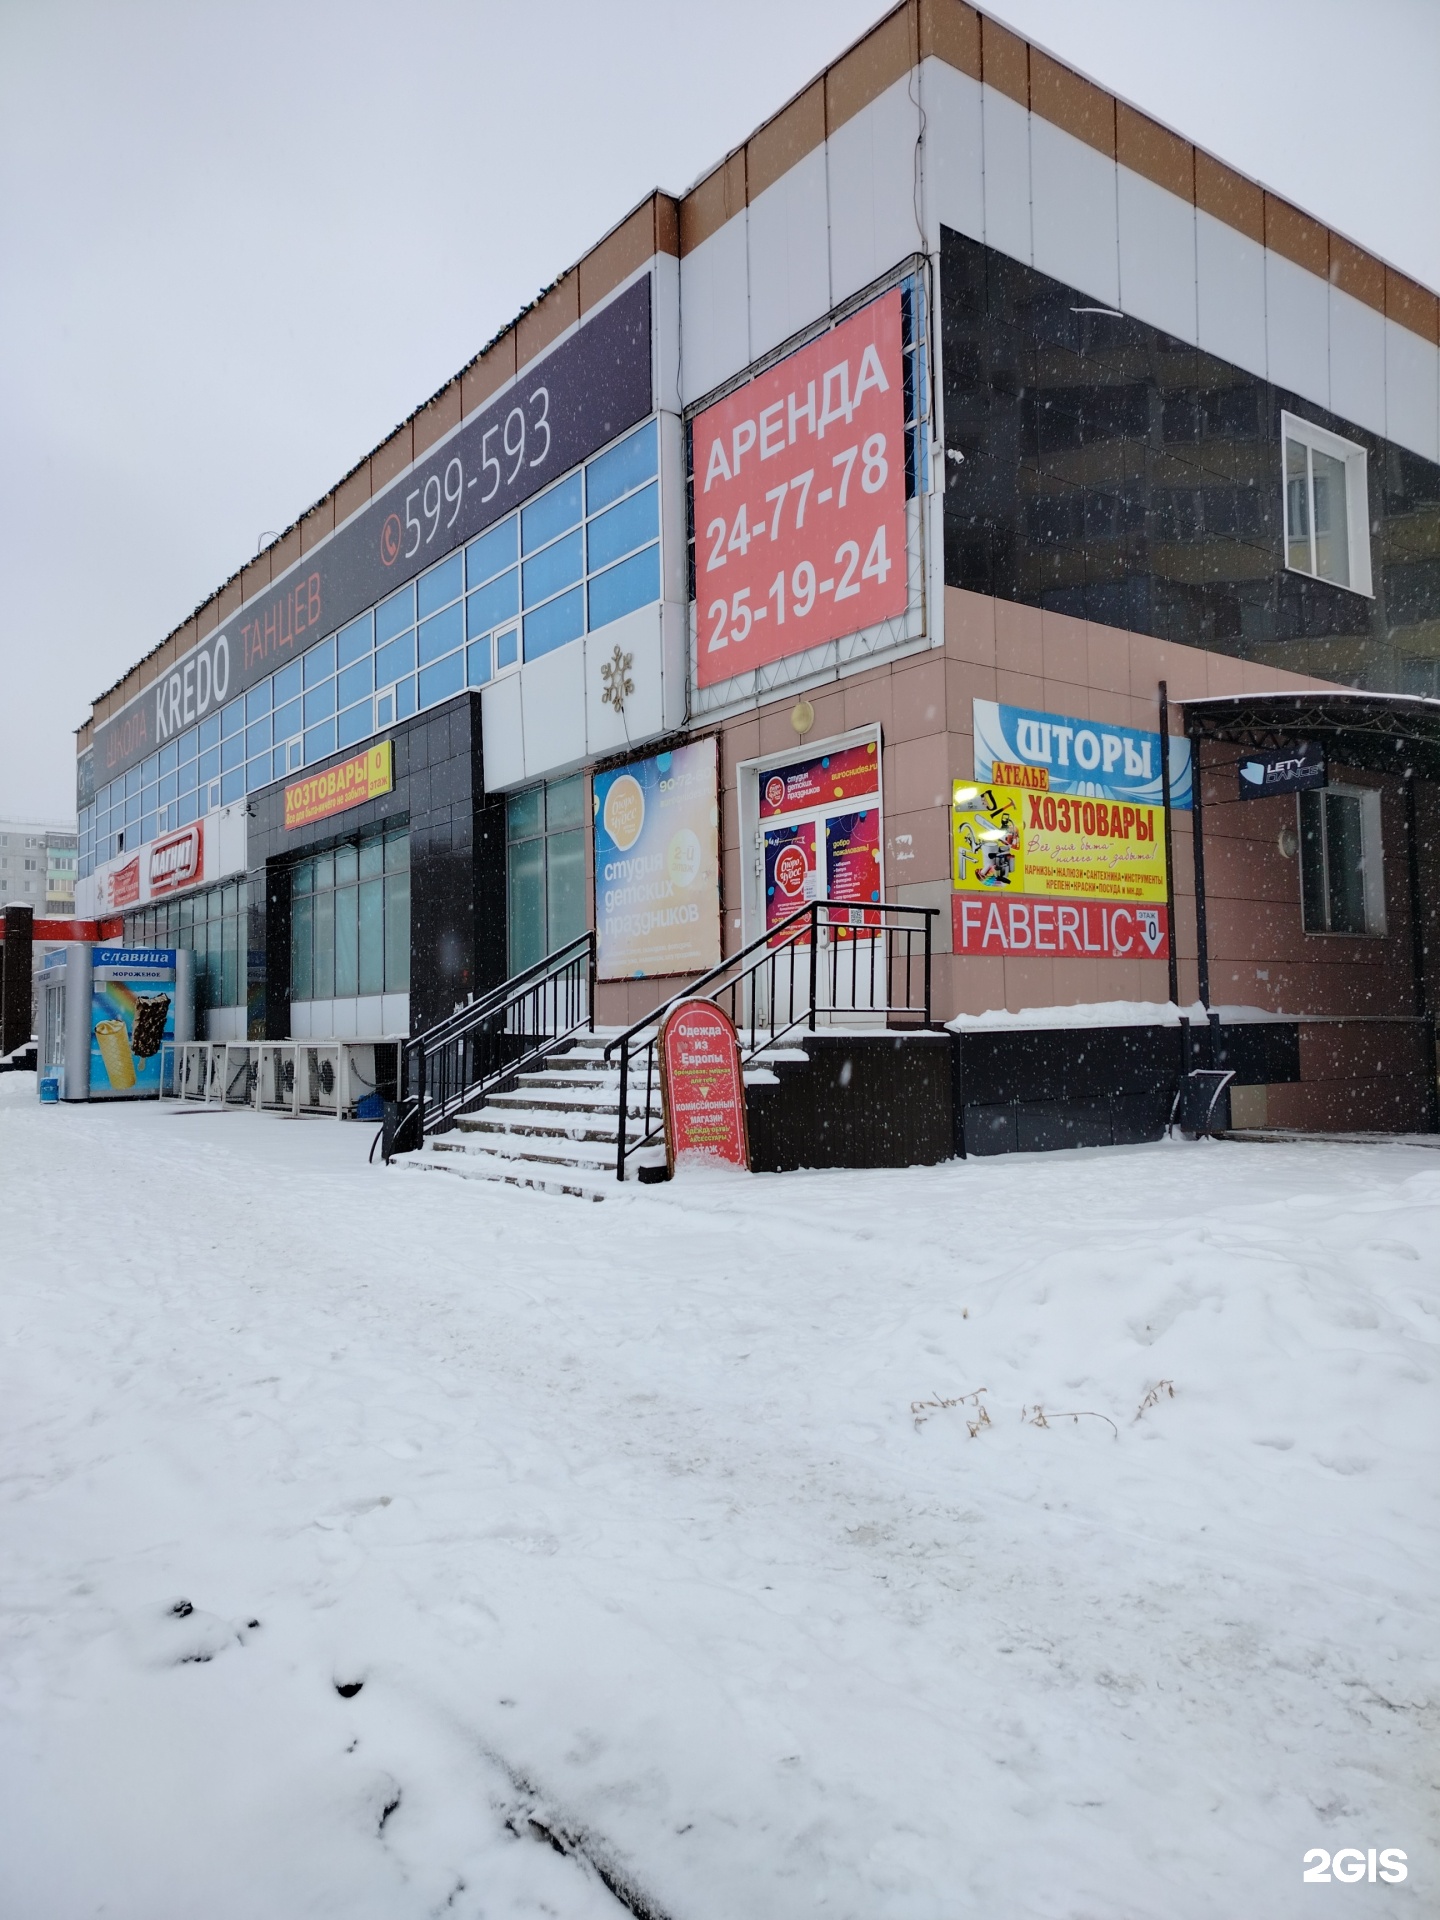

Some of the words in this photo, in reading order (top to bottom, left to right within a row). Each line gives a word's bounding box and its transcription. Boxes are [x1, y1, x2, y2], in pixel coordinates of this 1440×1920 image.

[703, 343, 890, 493] АРЕНДА
[405, 387, 552, 559] 599-593
[705, 432, 889, 573] 24-77-78
[707, 524, 892, 654] 25-19-24
[106, 708, 147, 769] ШКОЛА
[155, 634, 229, 744] KREDO
[241, 572, 320, 670] ТАНЦЕВ
[376, 752, 382, 769] 0
[1016, 717, 1153, 779] ШТОРЫ
[995, 762, 1047, 790] АТЕЛЬЕ
[1266, 757, 1306, 773] LETY
[1266, 765, 1319, 783] DANCE
[286, 756, 368, 812] ХОЗТОВАРЫ
[1027, 794, 1154, 842] ХОЗТОВАРЫ
[151, 840, 192, 879] МАГНИТ
[604, 853, 663, 882] студия
[1024, 864, 1053, 876] КАРНИЗЫ
[1056, 867, 1083, 878] ЖАЛЮЗИ
[1086, 869, 1121, 882] САНТЕХНИКА
[1124, 872, 1163, 885] ИНСТРУМЕНТЫ
[1046, 879, 1070, 889] КРЕПЕЖ
[1073, 881, 1096, 891] КРАСКИ
[1098, 883, 1120, 894] ПОСУДА
[605, 880, 674, 913] детских
[605, 903, 700, 938] праздников
[961, 901, 1133, 952] FABERLIC
[1138, 911, 1156, 919] ЭТАЖ
[1148, 921, 1156, 940] 0
[678, 1024, 722, 1037] Одежда
[681, 1052, 723, 1067] Европы
[694, 1041, 709, 1050] из
[676, 1099, 735, 1112] КОМИССИОННЫЙ
[690, 1114, 723, 1124] МАГАЗИН
